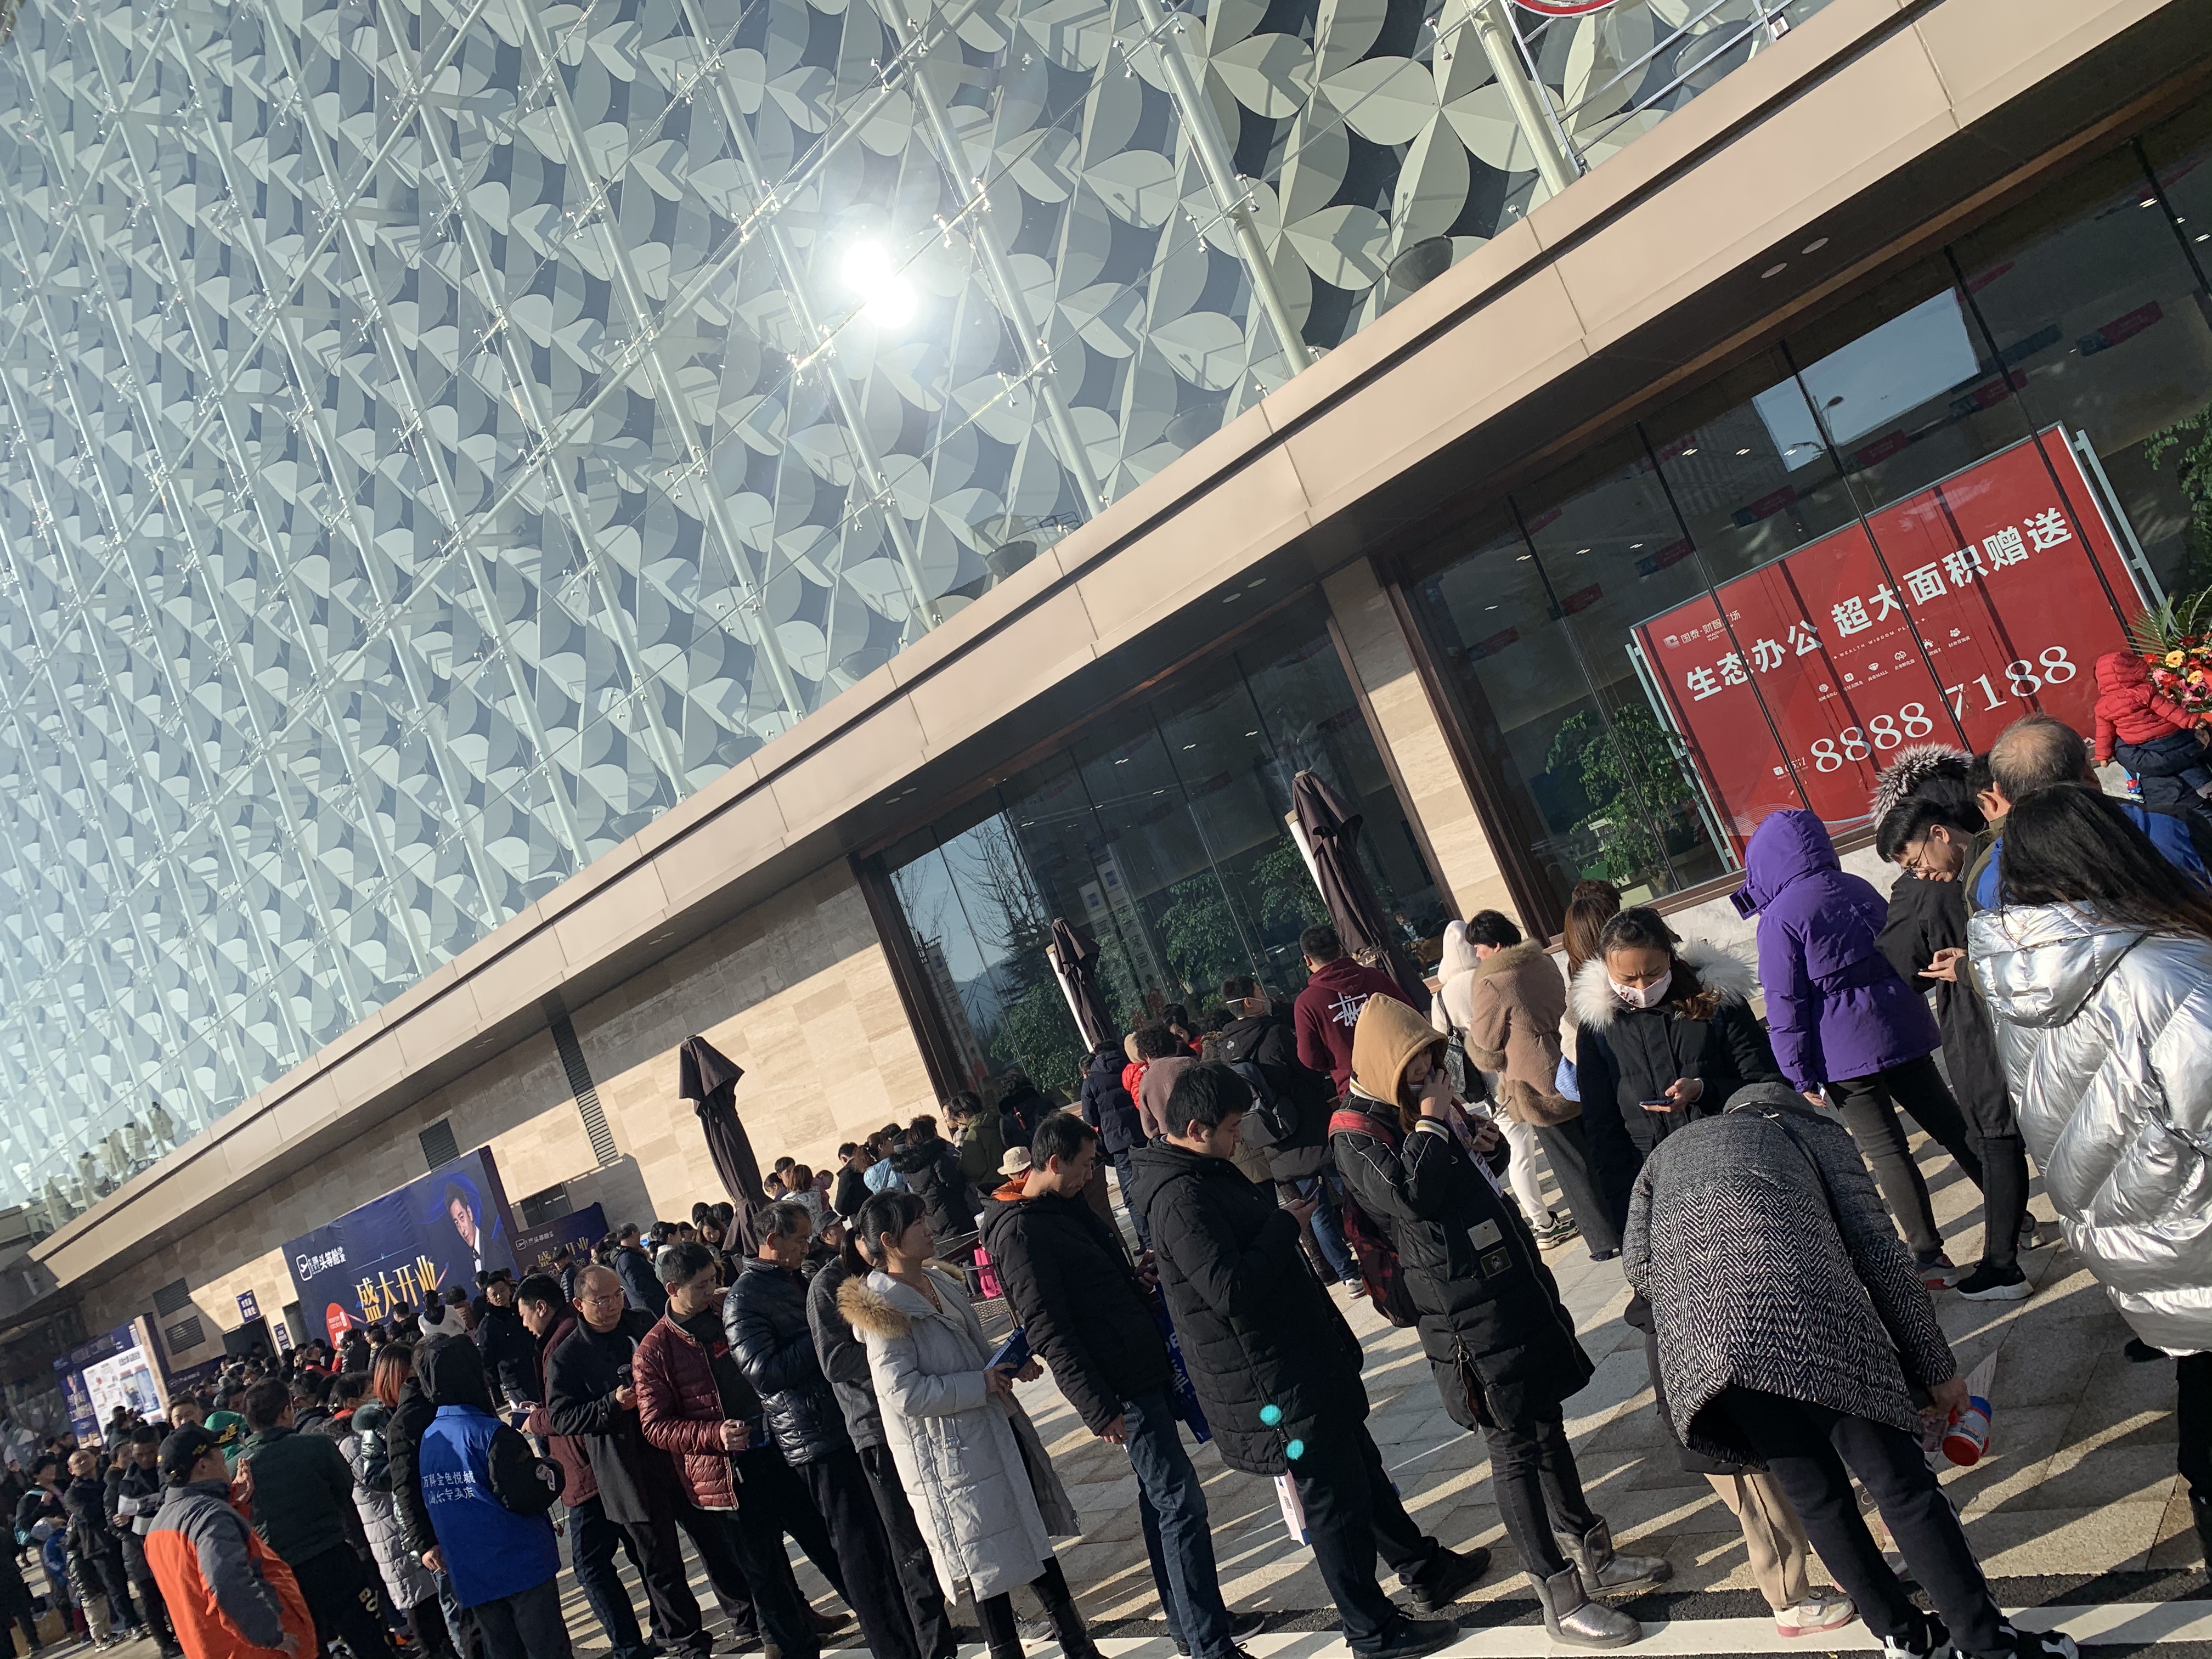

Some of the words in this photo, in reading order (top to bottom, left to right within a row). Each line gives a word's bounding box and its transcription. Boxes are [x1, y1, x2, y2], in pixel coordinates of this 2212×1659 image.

[1831, 507, 2072, 639] 超大面积赠送
[1680, 610, 1741, 644] 国泰·财智场
[1686, 620, 1821, 702] 生态办公
[1839, 643, 1865, 657] WEALTH
[1868, 630, 1895, 645] WISDOM
[1898, 620, 1919, 632] PLAA
[1810, 703, 1933, 772] 8888
[1939, 646, 2076, 725] 7188
[356, 1255, 443, 1323] 盛大开业
